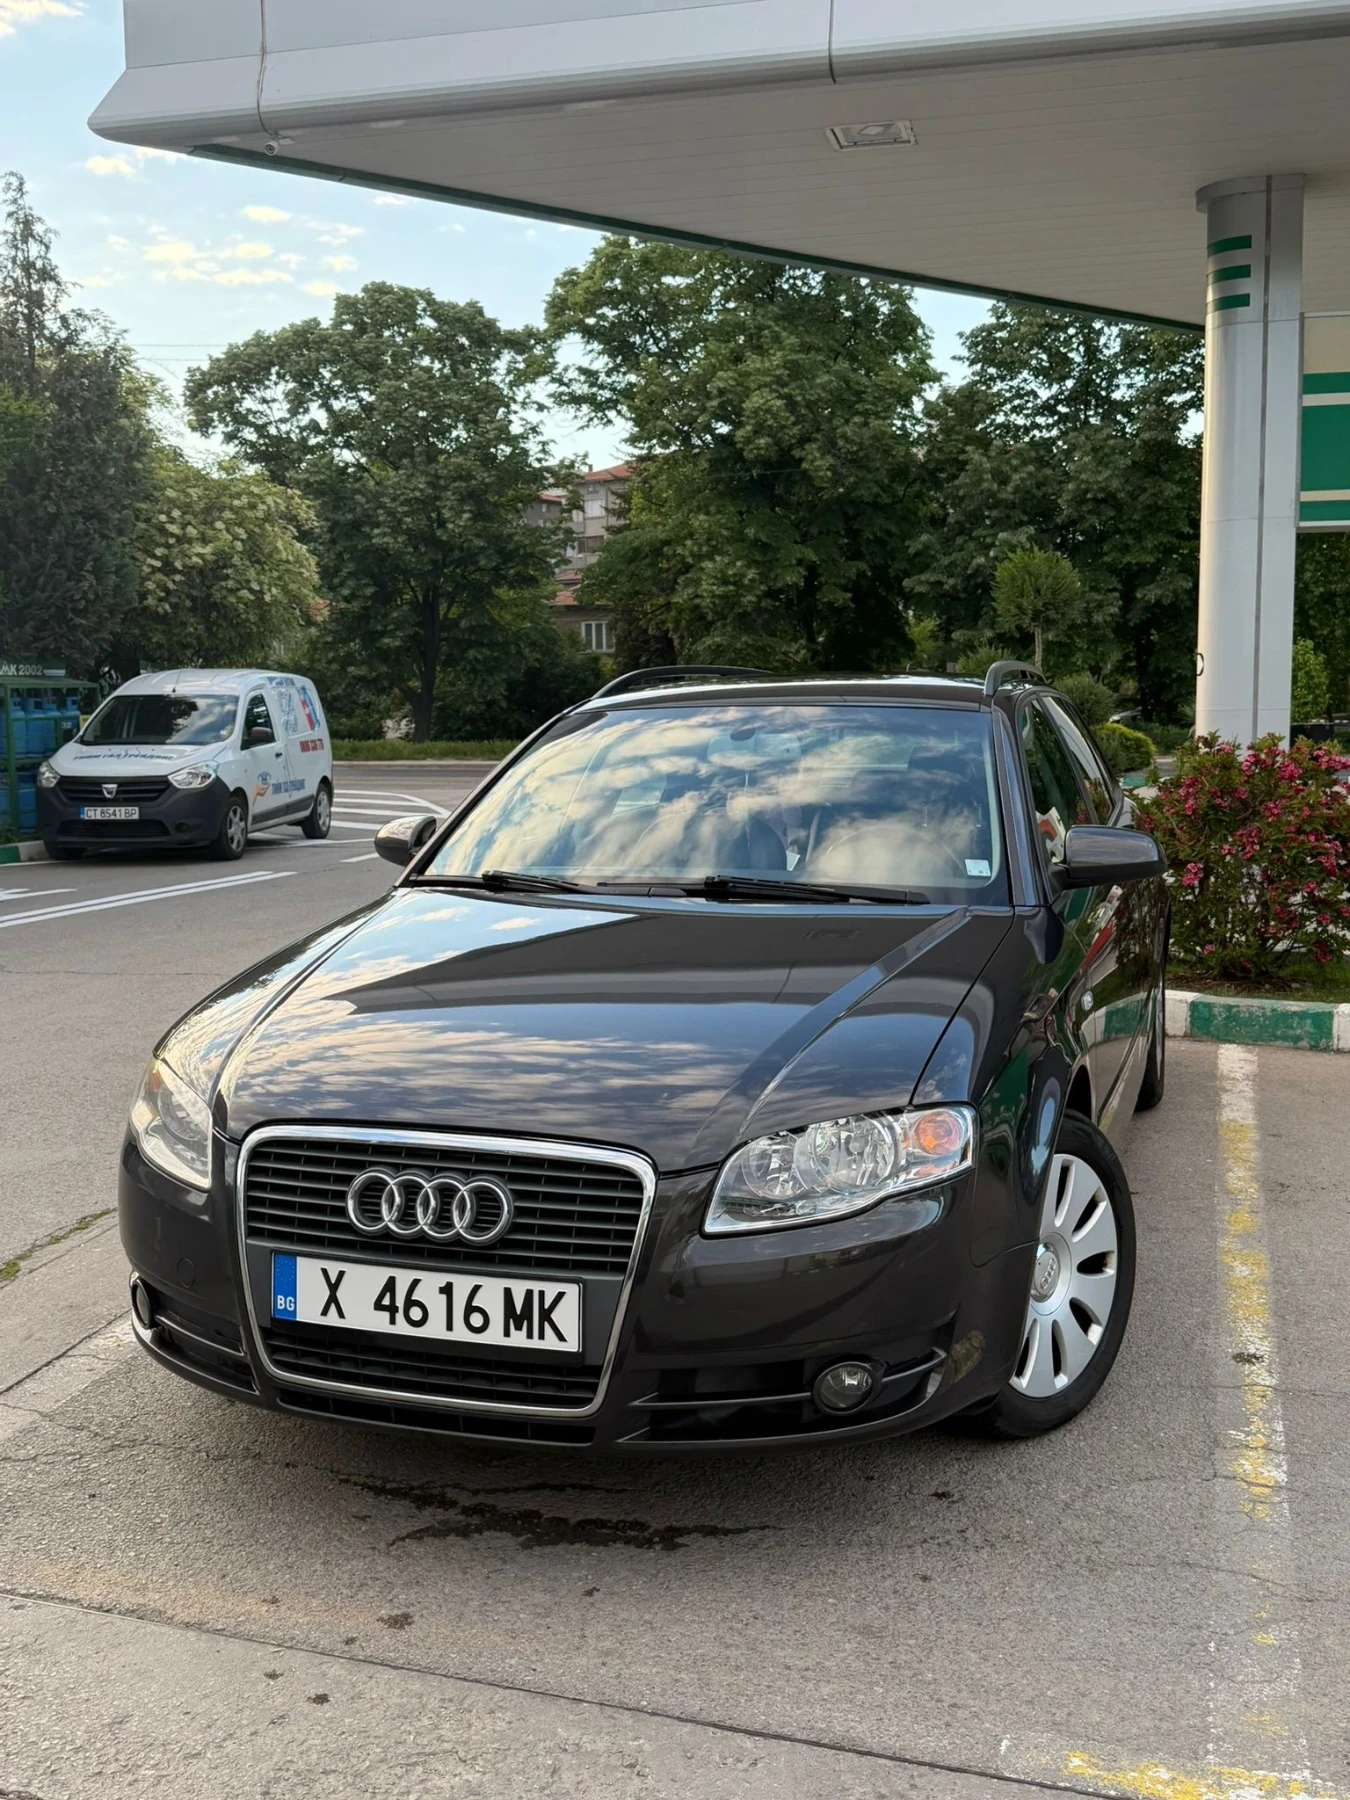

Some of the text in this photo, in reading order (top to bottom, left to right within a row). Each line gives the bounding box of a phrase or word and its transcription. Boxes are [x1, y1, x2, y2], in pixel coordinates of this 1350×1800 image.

[18, 664, 43, 676] 2002
[85, 808, 98, 819] CT
[100, 808, 122, 819] 8541
[124, 808, 137, 819] BP
[276, 1295, 295, 1311] BG
[319, 1266, 568, 1343] X 4616 MK
